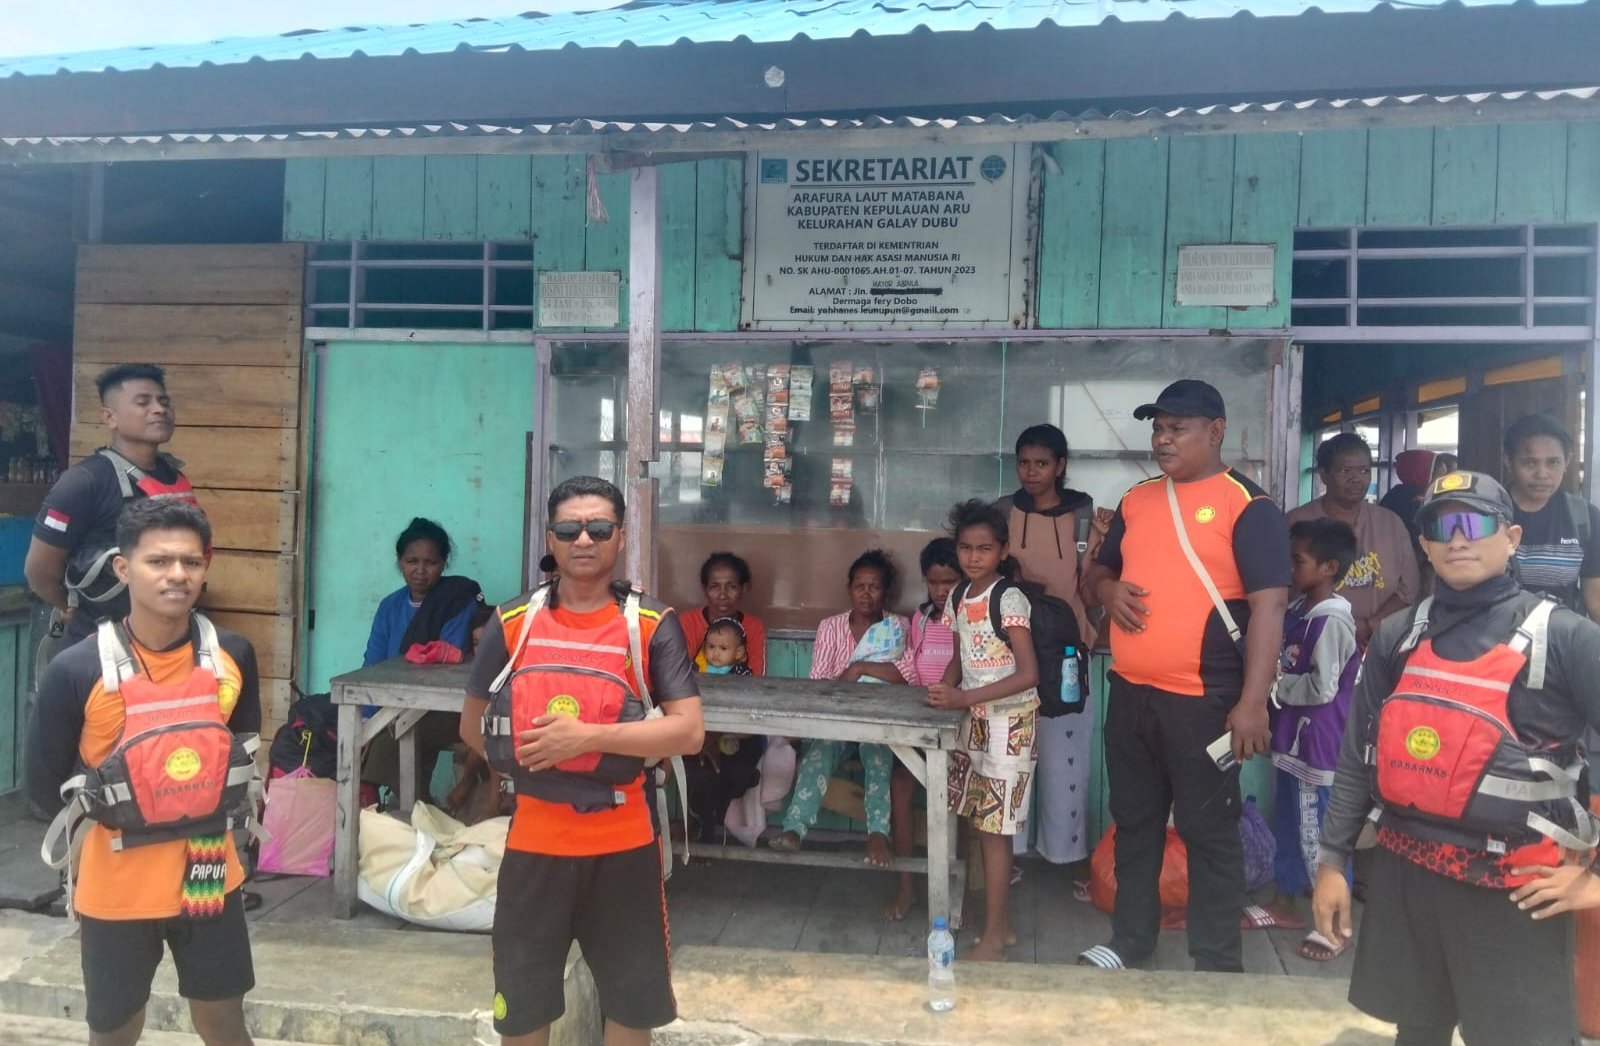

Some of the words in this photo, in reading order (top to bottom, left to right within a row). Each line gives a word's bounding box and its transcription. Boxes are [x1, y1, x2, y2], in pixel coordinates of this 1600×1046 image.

[796, 156, 973, 182] SEKRETARIAT
[793, 192, 851, 203] ARAFURA
[855, 192, 887, 203] LAUT
[891, 190, 965, 202] MATABANA
[787, 205, 860, 217] KABUPATEN
[863, 204, 939, 216] KEPULAUAN
[943, 203, 971, 215] ARU
[797, 218, 873, 230] KELURAHAN
[876, 217, 918, 229] GALAY
[921, 217, 959, 228] DUBU
[813, 241, 865, 250] TERDAFTAR
[866, 241, 877, 250] DI
[878, 240, 939, 250] KEMENTRIAN
[794, 254, 829, 263] HUKUM
[831, 254, 853, 263] DAN
[854, 254, 874, 262] HAK
[875, 253, 902, 262] ASASI
[904, 252, 949, 262] MANUSIA
[951, 252, 961, 262] RI
[779, 267, 796, 275] NO.
[797, 266, 809, 275] SK
[919, 266, 952, 275] TAHUN
[953, 265, 976, 274] 2023
[808, 287, 847, 295] ALAMAT
[832, 297, 872, 306] Dermaga
[874, 297, 892, 306] fery
[894, 297, 918, 305] Dobo
[790, 305, 816, 314] Email:
[190, 863, 227, 880] PAPUA
